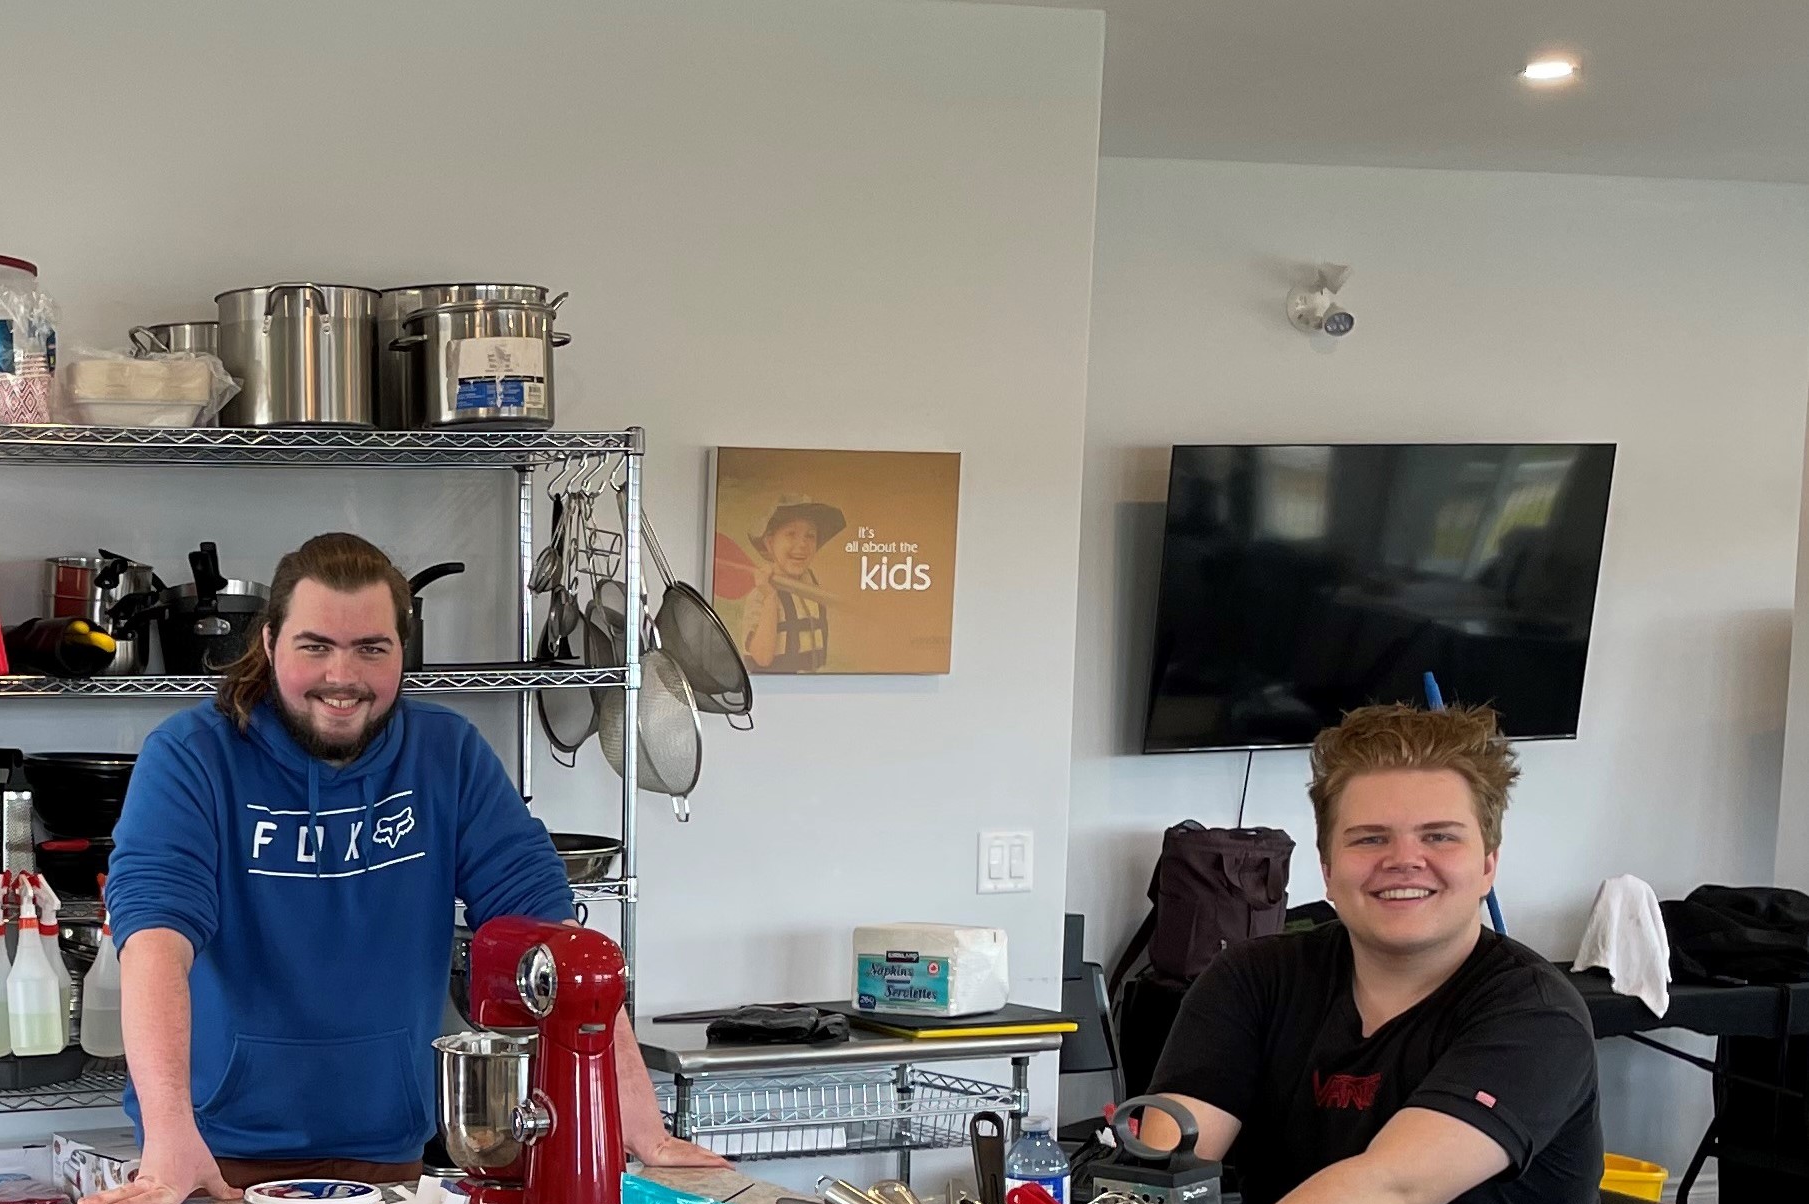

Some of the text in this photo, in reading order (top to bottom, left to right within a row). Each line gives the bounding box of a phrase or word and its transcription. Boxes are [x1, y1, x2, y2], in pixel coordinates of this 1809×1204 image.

[845, 541, 918, 553] all about the
[860, 555, 931, 591] kids
